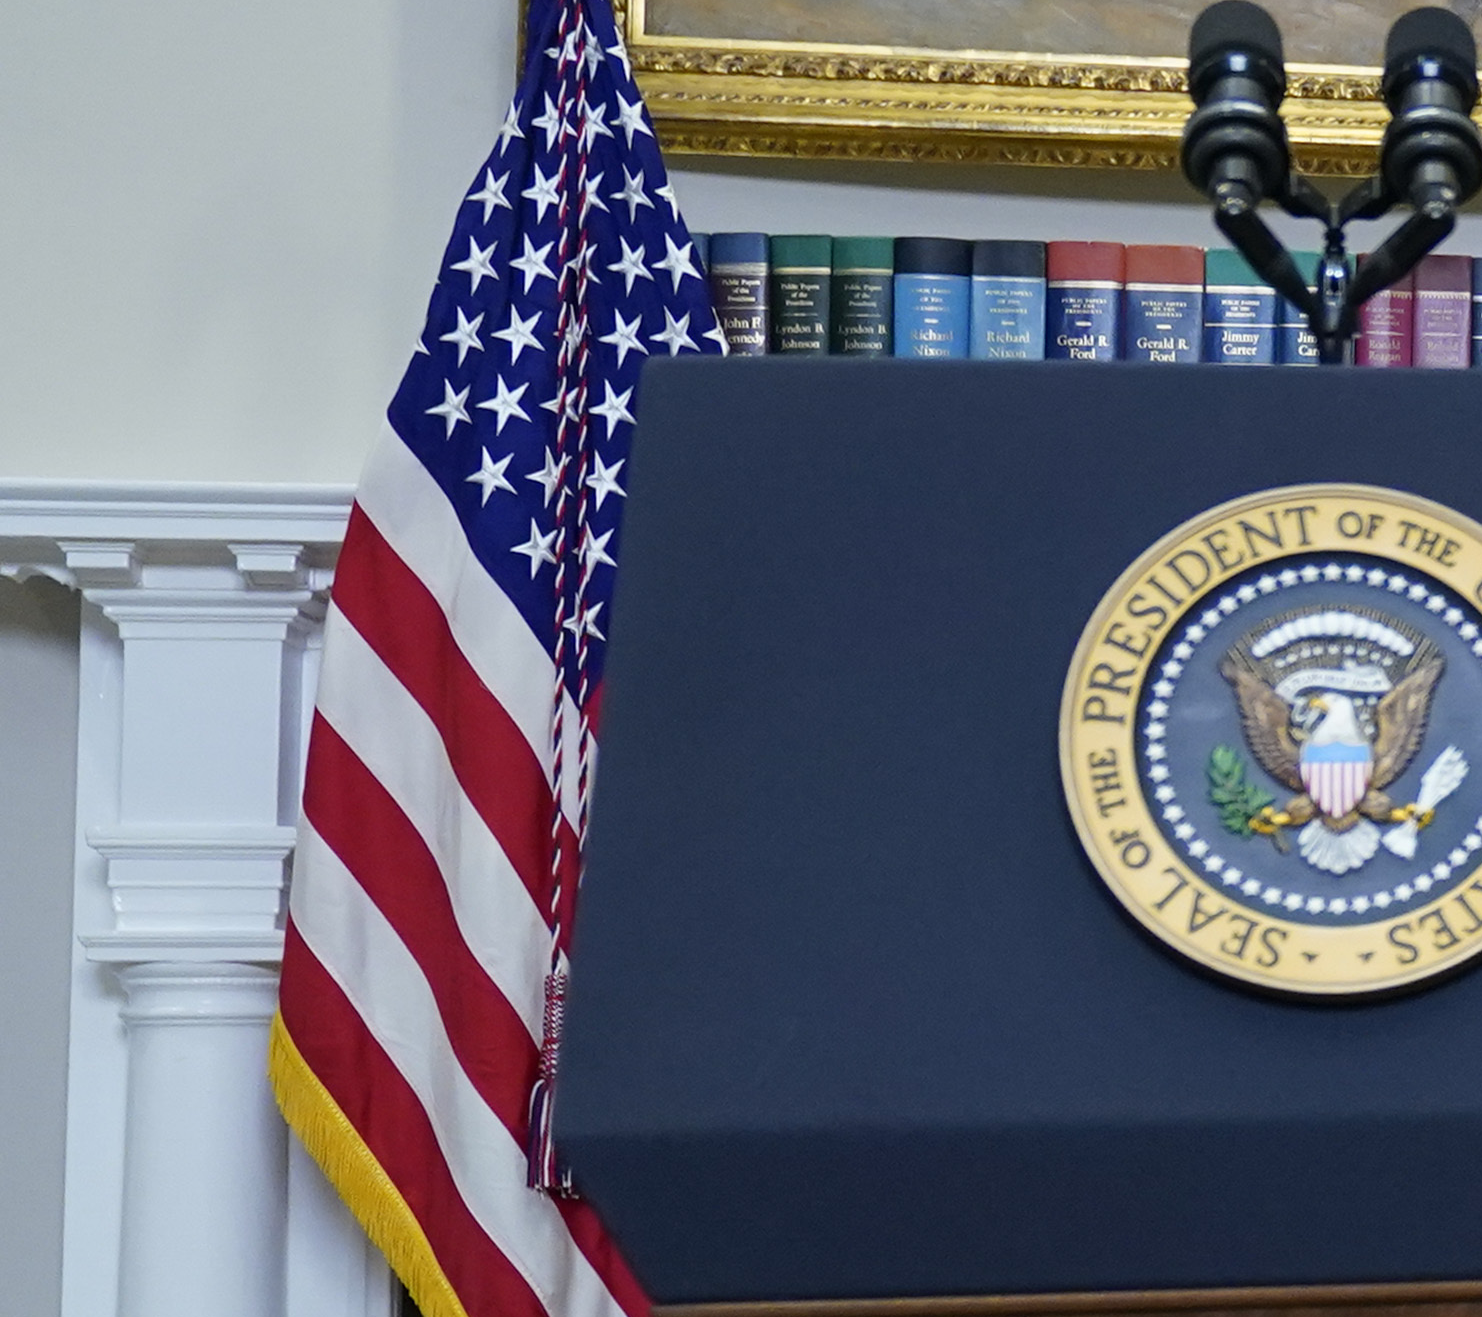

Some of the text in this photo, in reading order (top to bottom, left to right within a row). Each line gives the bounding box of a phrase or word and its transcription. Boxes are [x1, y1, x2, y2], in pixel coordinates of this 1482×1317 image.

[724, 317, 750, 329] John
[728, 331, 766, 347] ennedy
[910, 329, 954, 342] Richard
[986, 331, 1030, 344] Richard
[1057, 335, 1094, 347] Gerald
[1222, 331, 1260, 345] Jimmy
[1297, 331, 1318, 344] Jim
[781, 339, 820, 351] Johnson
[844, 339, 882, 351] Johnson
[1136, 337, 1174, 350] Gerald
[1222, 344, 1258, 356] Carter
[913, 345, 950, 357] Nixon
[988, 347, 1027, 358] Nixon
[1070, 348, 1096, 360] Ford
[1150, 351, 1176, 363] Ford
[1298, 345, 1320, 357] Car
[1334, 510, 1388, 540] OF
[1397, 521, 1461, 570] THE
[1082, 506, 1318, 726] PRESIDENT
[1087, 747, 1126, 817] THE
[1109, 824, 1152, 870] OF
[1161, 866, 1289, 969] SEAL
